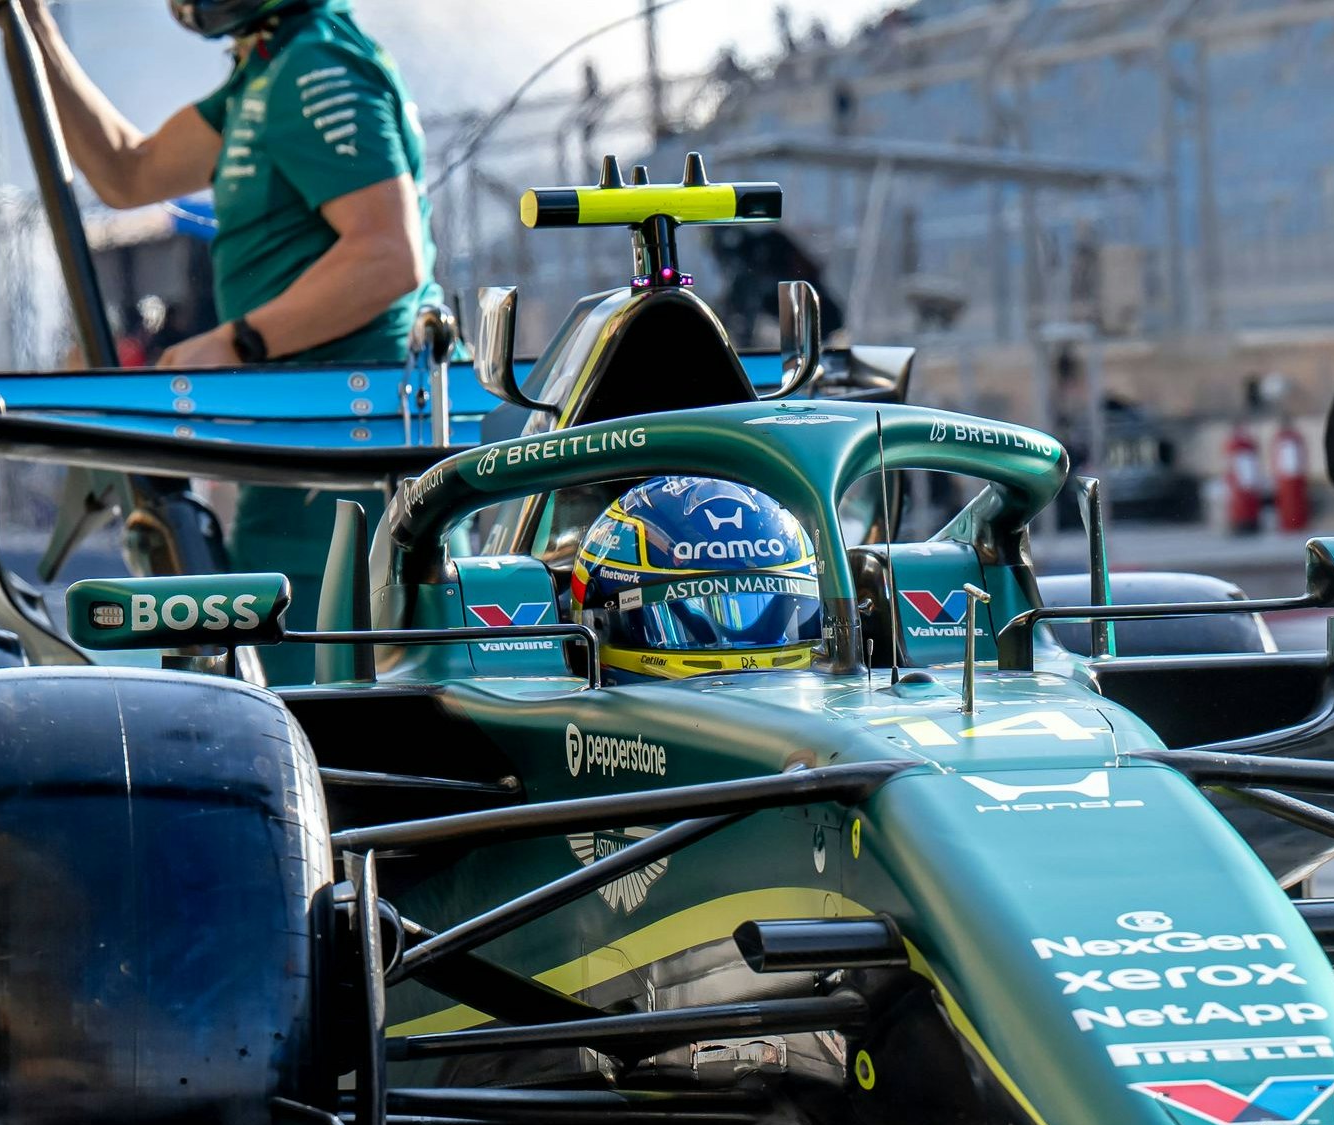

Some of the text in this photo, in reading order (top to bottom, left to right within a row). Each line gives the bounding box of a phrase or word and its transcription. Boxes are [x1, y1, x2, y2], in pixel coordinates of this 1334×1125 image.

[507, 428, 647, 466] BREITLING
[955, 420, 1053, 457] BREITLING
[674, 538, 785, 560] aramco
[599, 567, 640, 584] finetwork
[664, 576, 801, 600] ASTON MARTIN
[131, 595, 260, 631] BOSS
[478, 640, 553, 652] Valvoline
[868, 711, 1110, 747] 14
[586, 733, 666, 777] pepperstone
[975, 799, 1145, 813] Honda
[1030, 931, 1288, 960] NexGen
[1054, 962, 1308, 995] xerox
[1071, 1001, 1329, 1032] NetApp
